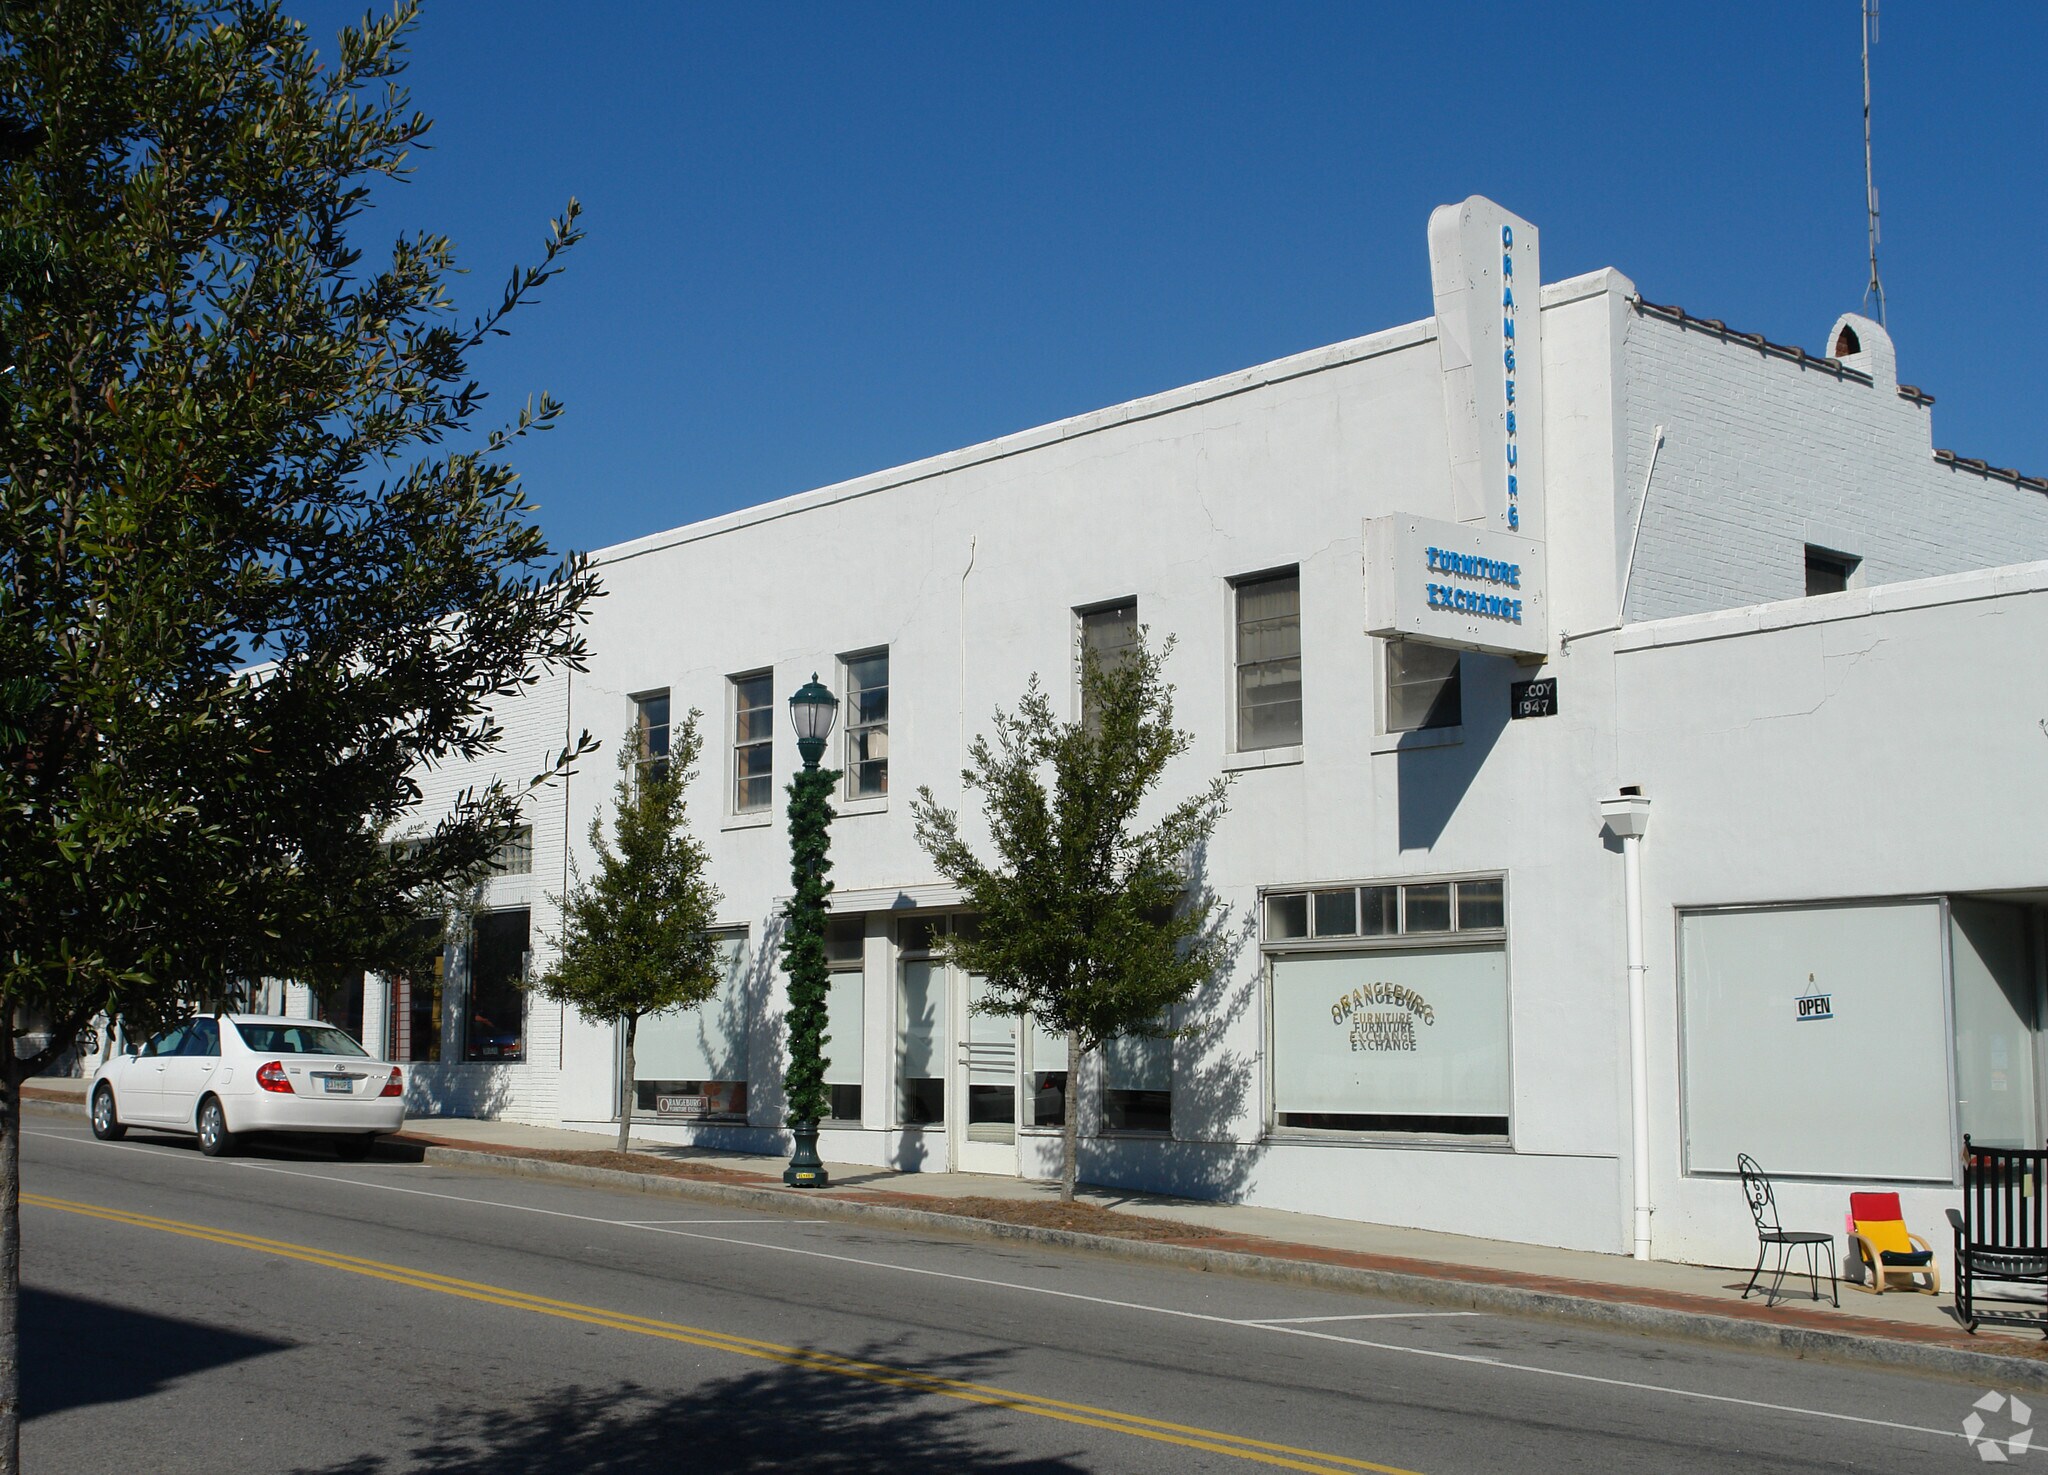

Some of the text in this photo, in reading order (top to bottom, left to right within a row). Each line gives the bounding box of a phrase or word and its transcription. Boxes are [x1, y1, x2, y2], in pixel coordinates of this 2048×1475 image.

[1501, 225, 1519, 527] ORANGEBURG
[1427, 547, 1520, 585] FURNITURE
[1427, 583, 1522, 621] EXCHANGE
[1519, 699, 1549, 715] 1947
[1331, 982, 1434, 1019] ORANGEBURG
[1798, 997, 1831, 1016] OPEN
[1353, 1012, 1414, 1025] FURNITURE
[1350, 1030, 1416, 1044] EXCHANGE
[660, 1098, 702, 1112] ORANGEBURG
